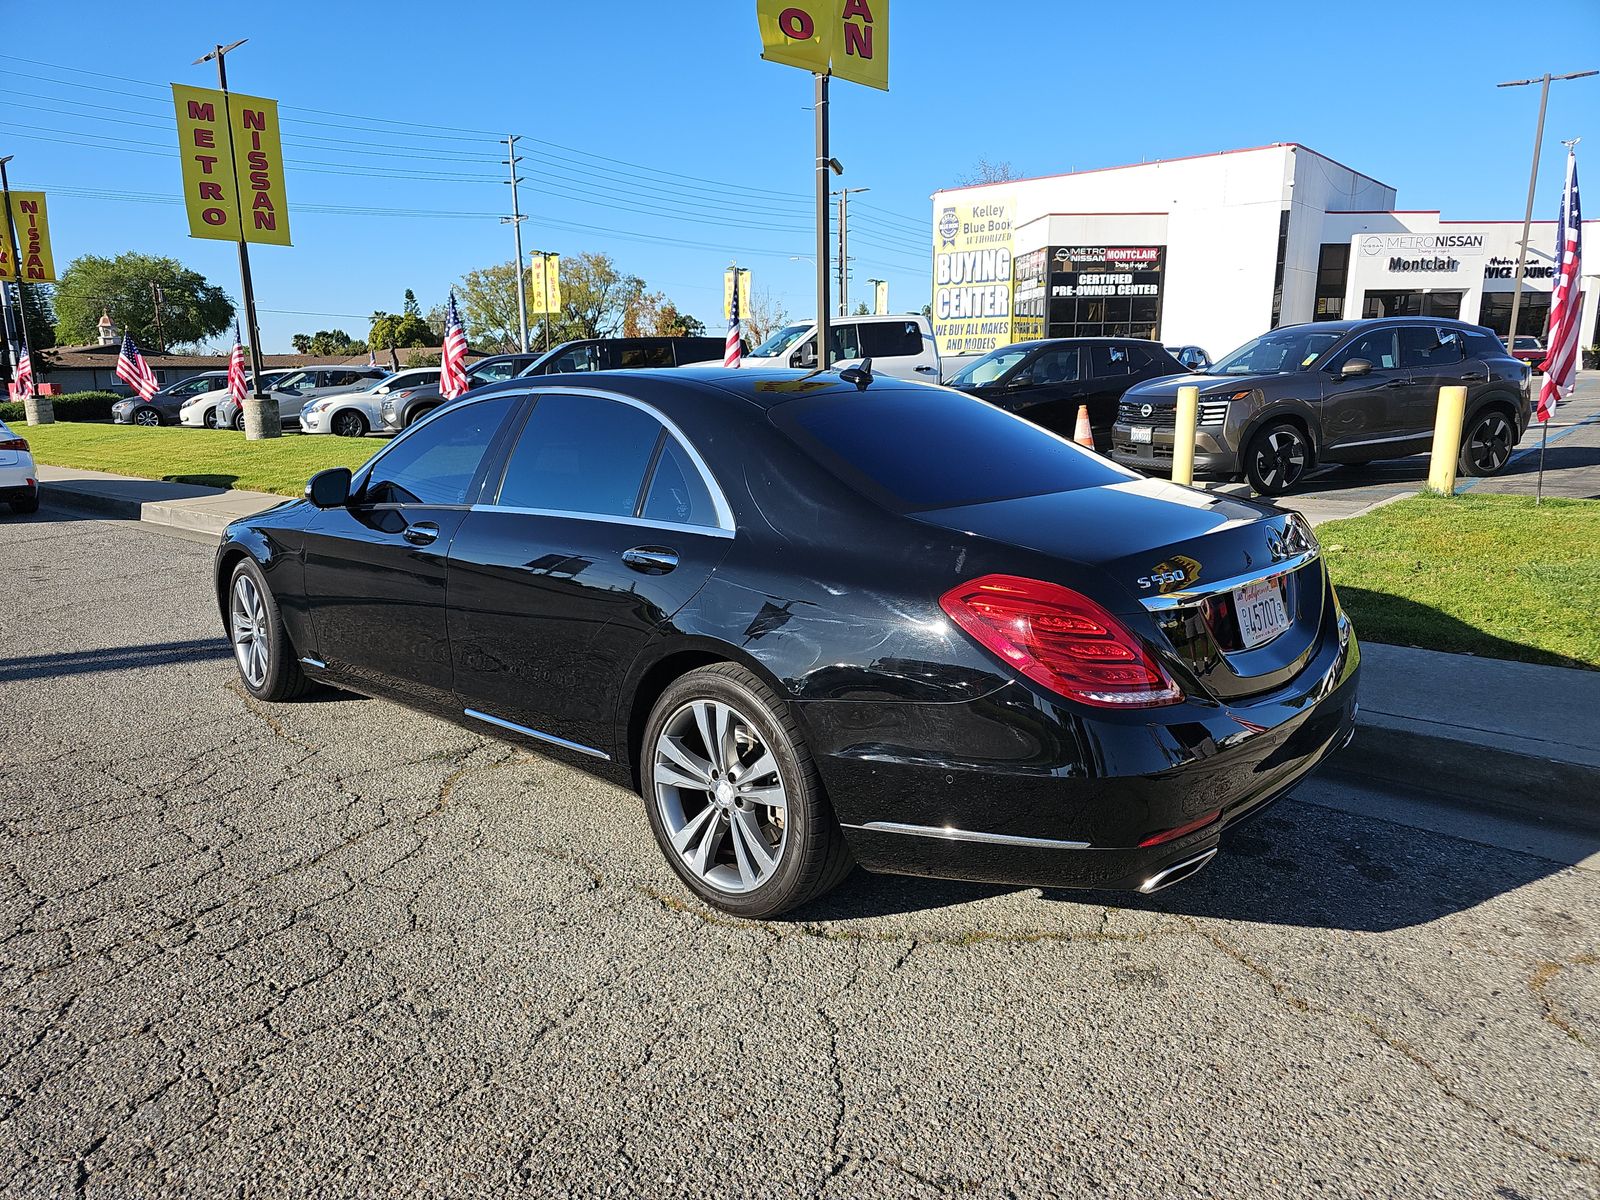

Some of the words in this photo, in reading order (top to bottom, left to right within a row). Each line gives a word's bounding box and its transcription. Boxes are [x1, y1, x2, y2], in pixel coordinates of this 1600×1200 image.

[187, 100, 227, 226] METRO
[243, 109, 276, 231] NISSAN
[973, 205, 1004, 218] Kelley
[963, 223, 985, 234] Blue
[20, 200, 46, 280] NISSAN
[1106, 249, 1157, 259] MONTCLAIR
[1490, 256, 1514, 266] Metro
[1515, 258, 1540, 266] Nsan
[937, 247, 1011, 285] BUYING
[1388, 256, 1458, 271] Montclair
[1079, 274, 1133, 284] CERTIFIED
[1052, 285, 1116, 296] PRE-OWNED
[1117, 284, 1158, 295] CENTER
[936, 285, 1009, 320] CENTER
[935, 324, 948, 336] WE
[949, 323, 964, 335] BUY
[965, 323, 979, 335] ALL
[981, 321, 1009, 334] MAKES
[946, 338, 962, 350] AND
[964, 337, 996, 350] MODELS
[1247, 597, 1279, 634] 45707
